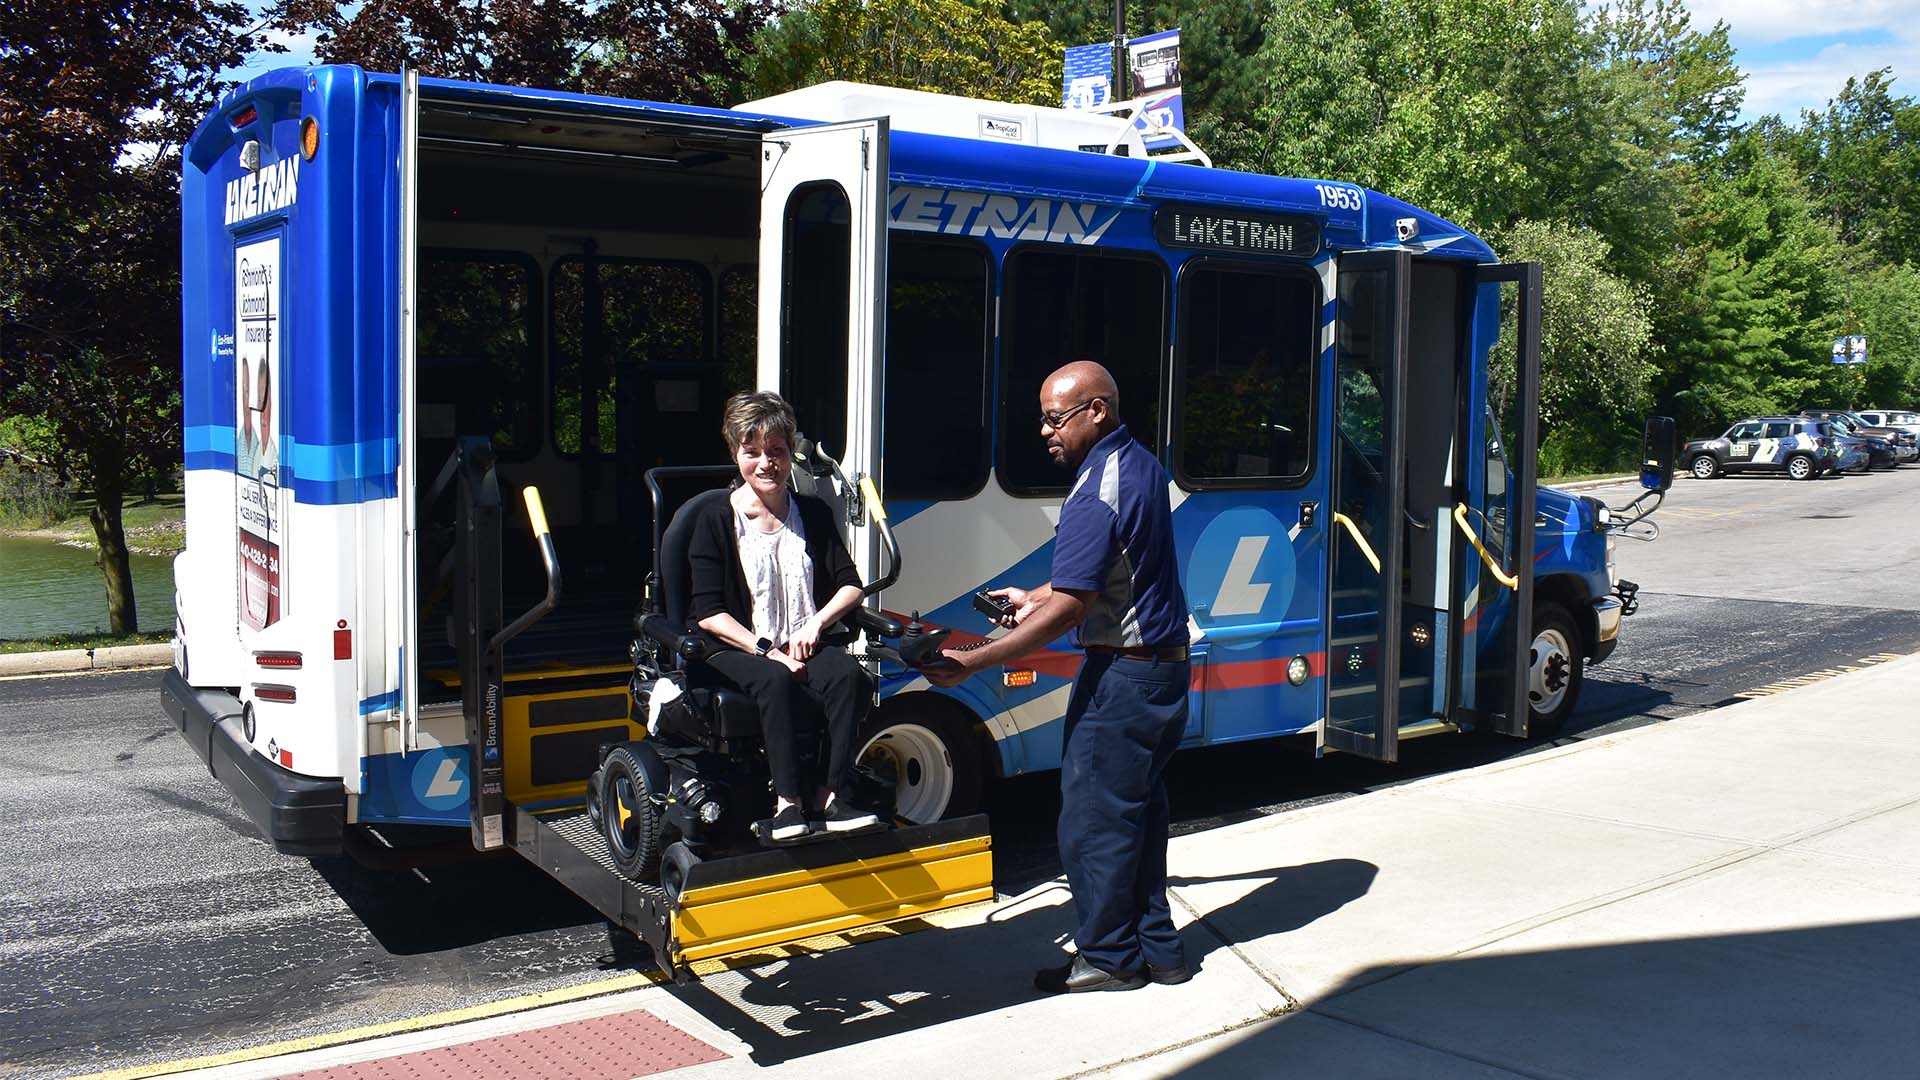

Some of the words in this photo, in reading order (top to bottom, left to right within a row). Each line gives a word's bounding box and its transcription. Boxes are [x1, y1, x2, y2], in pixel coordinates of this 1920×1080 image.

[225, 153, 300, 225] LAKETRAN
[1314, 184, 1362, 212] 1953
[1174, 213, 1294, 251] LAKETRAN
[486, 683, 499, 746] BraunAbility
